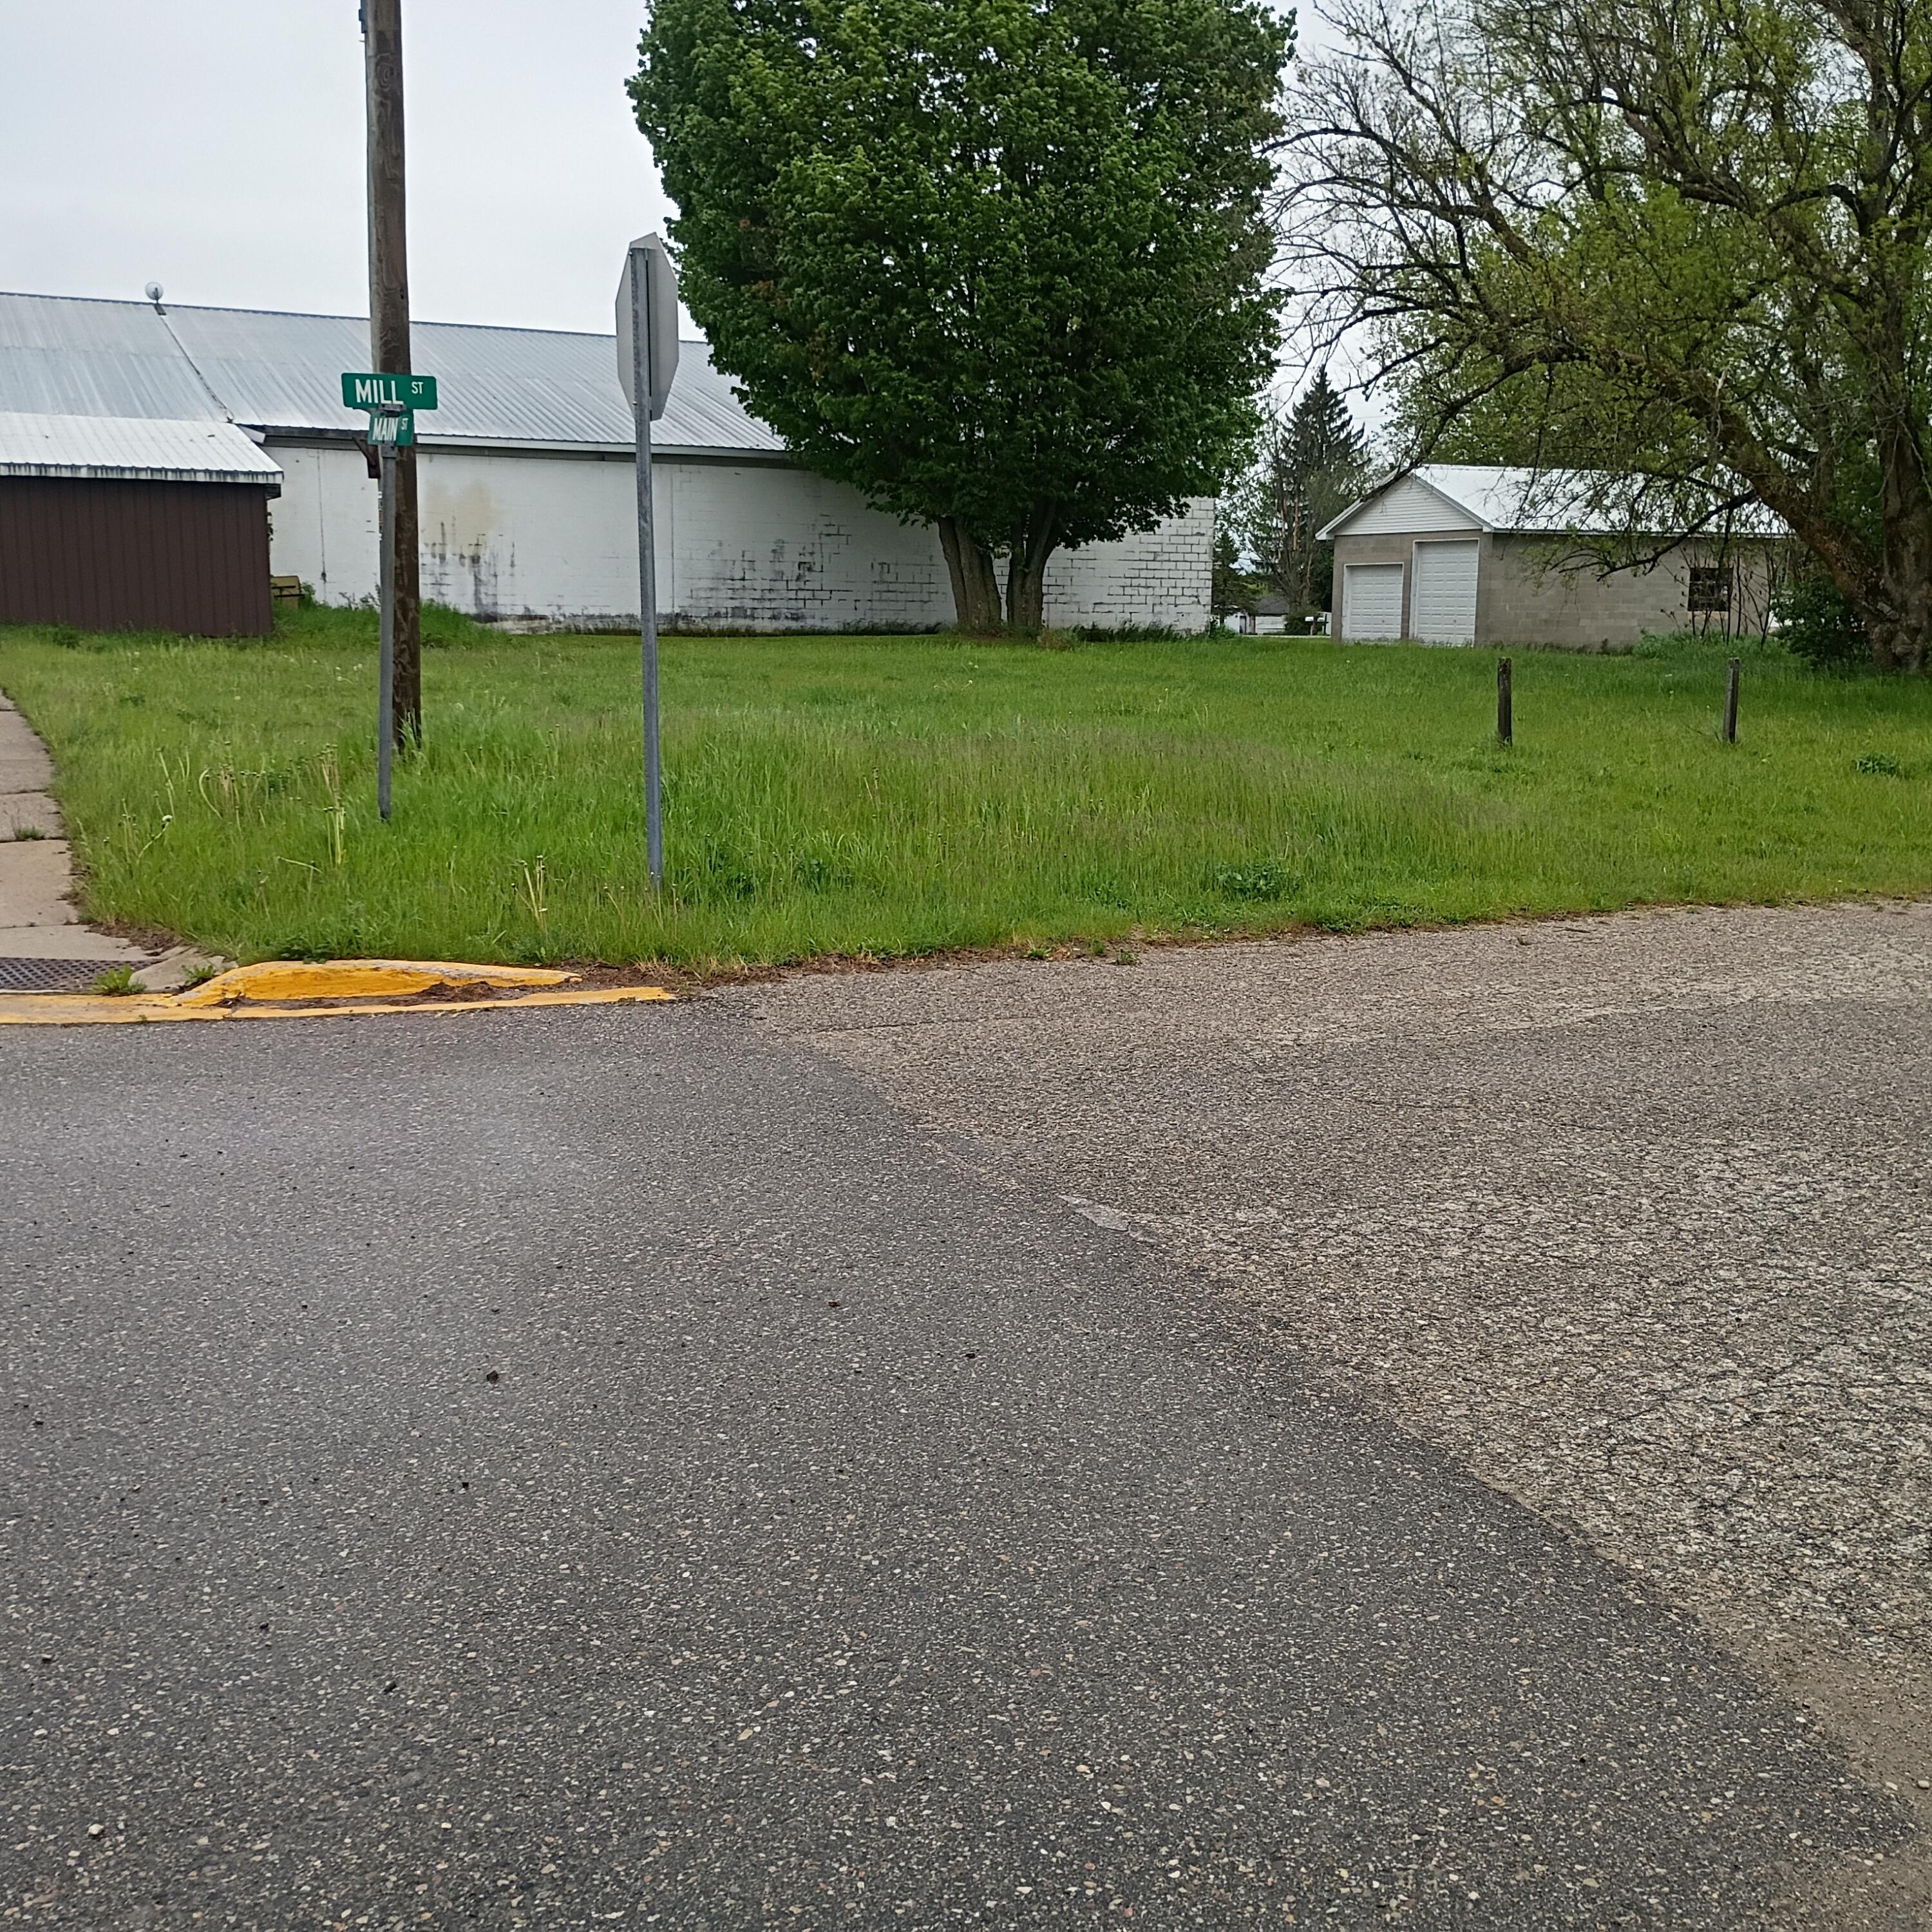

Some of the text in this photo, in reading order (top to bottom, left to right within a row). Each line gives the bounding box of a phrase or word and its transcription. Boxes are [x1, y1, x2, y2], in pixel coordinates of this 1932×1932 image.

[355, 379, 424, 404] MILL ST
[372, 417, 408, 441] MAIN ST
